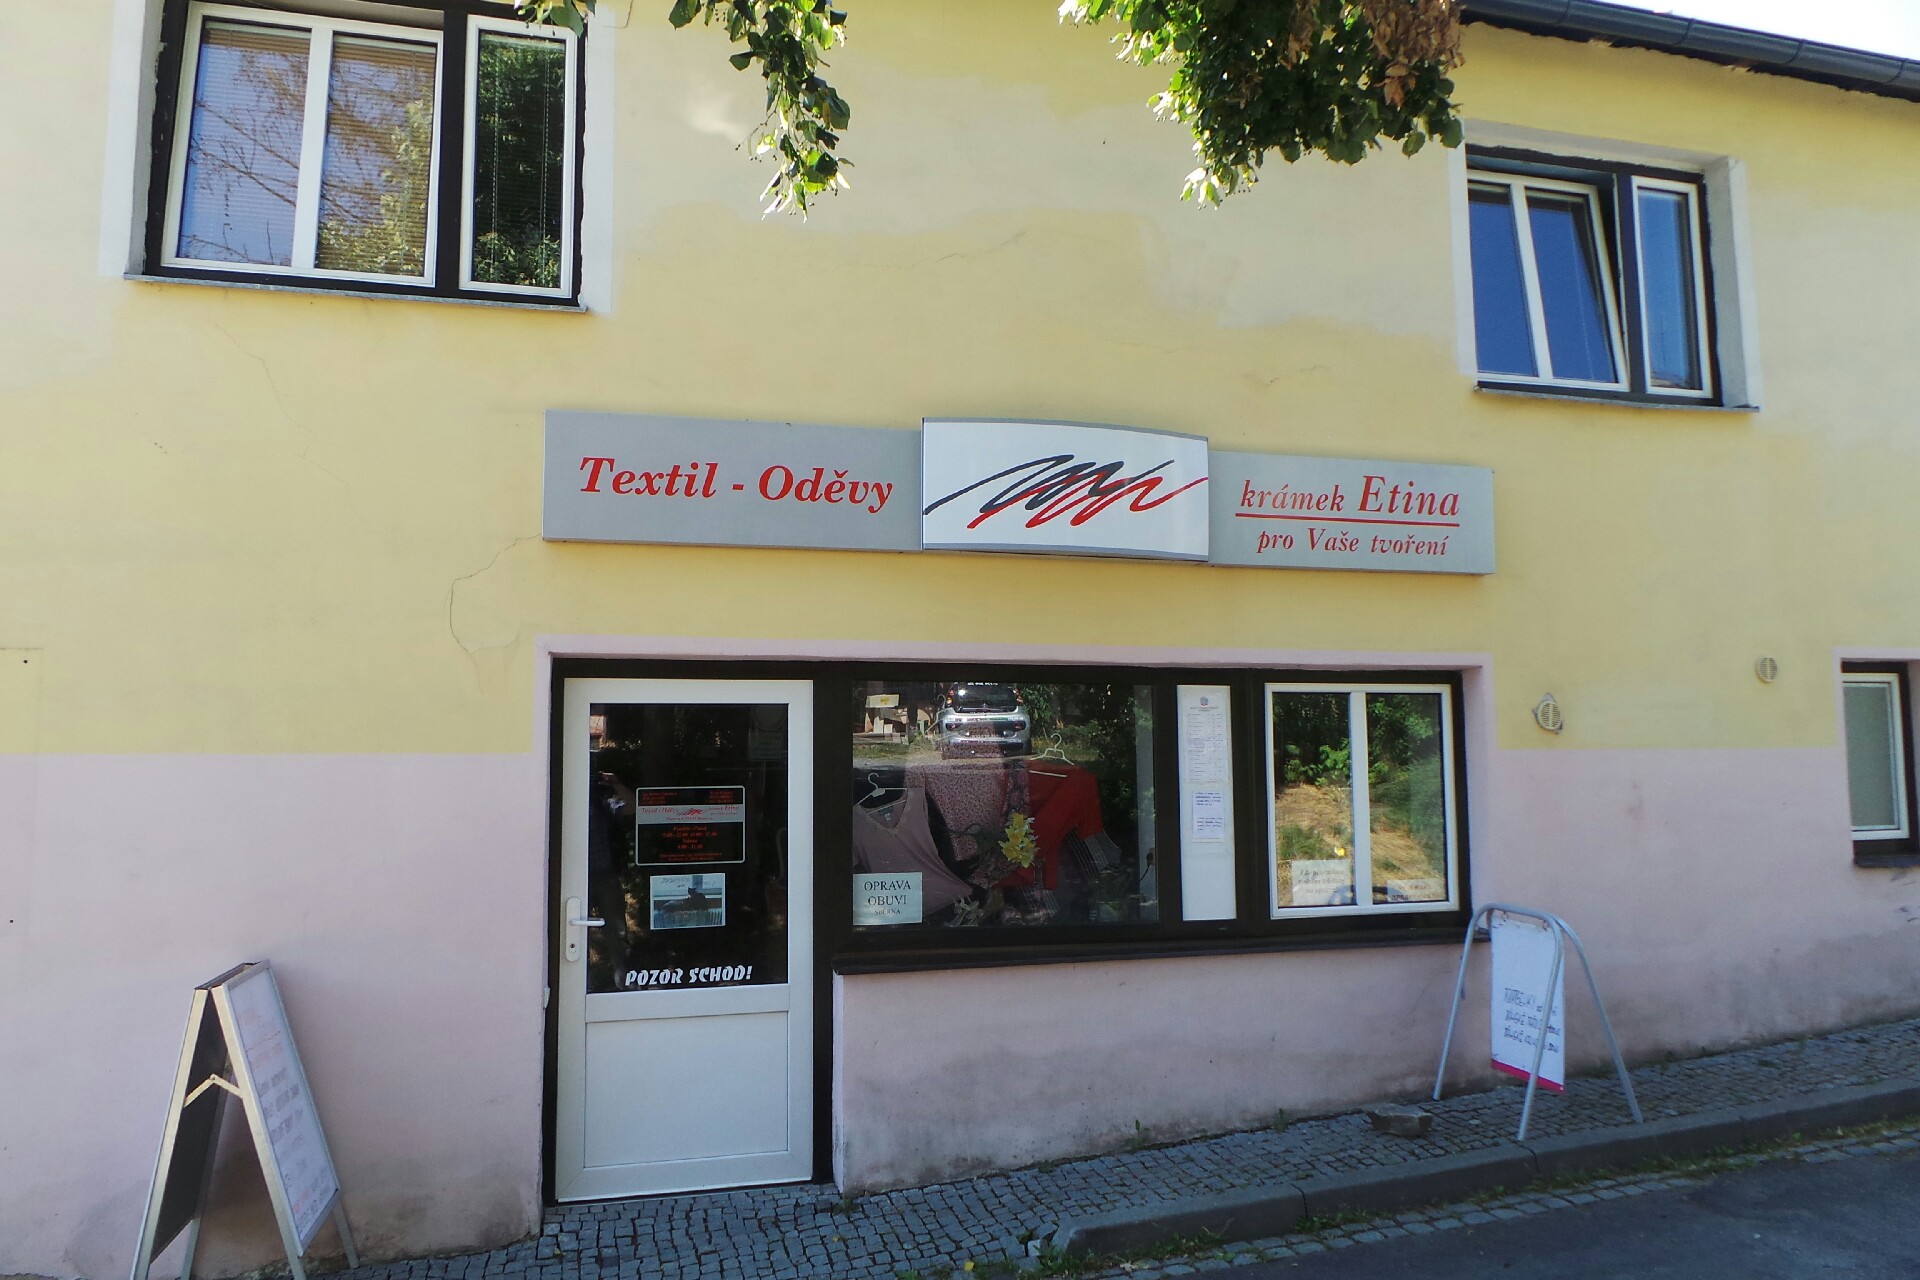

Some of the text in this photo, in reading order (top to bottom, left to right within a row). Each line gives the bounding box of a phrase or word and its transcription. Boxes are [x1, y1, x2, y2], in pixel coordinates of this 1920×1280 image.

[579, 456, 719, 498] Textil
[758, 465, 893, 514] Oděvy
[1240, 475, 1460, 516] krámek Etina
[1256, 528, 1450, 556] pro Vaše tvoření
[864, 880, 911, 891] OPRAVA
[868, 895, 907, 906] OBUVI
[625, 965, 753, 986] POZOR SCHOD!
